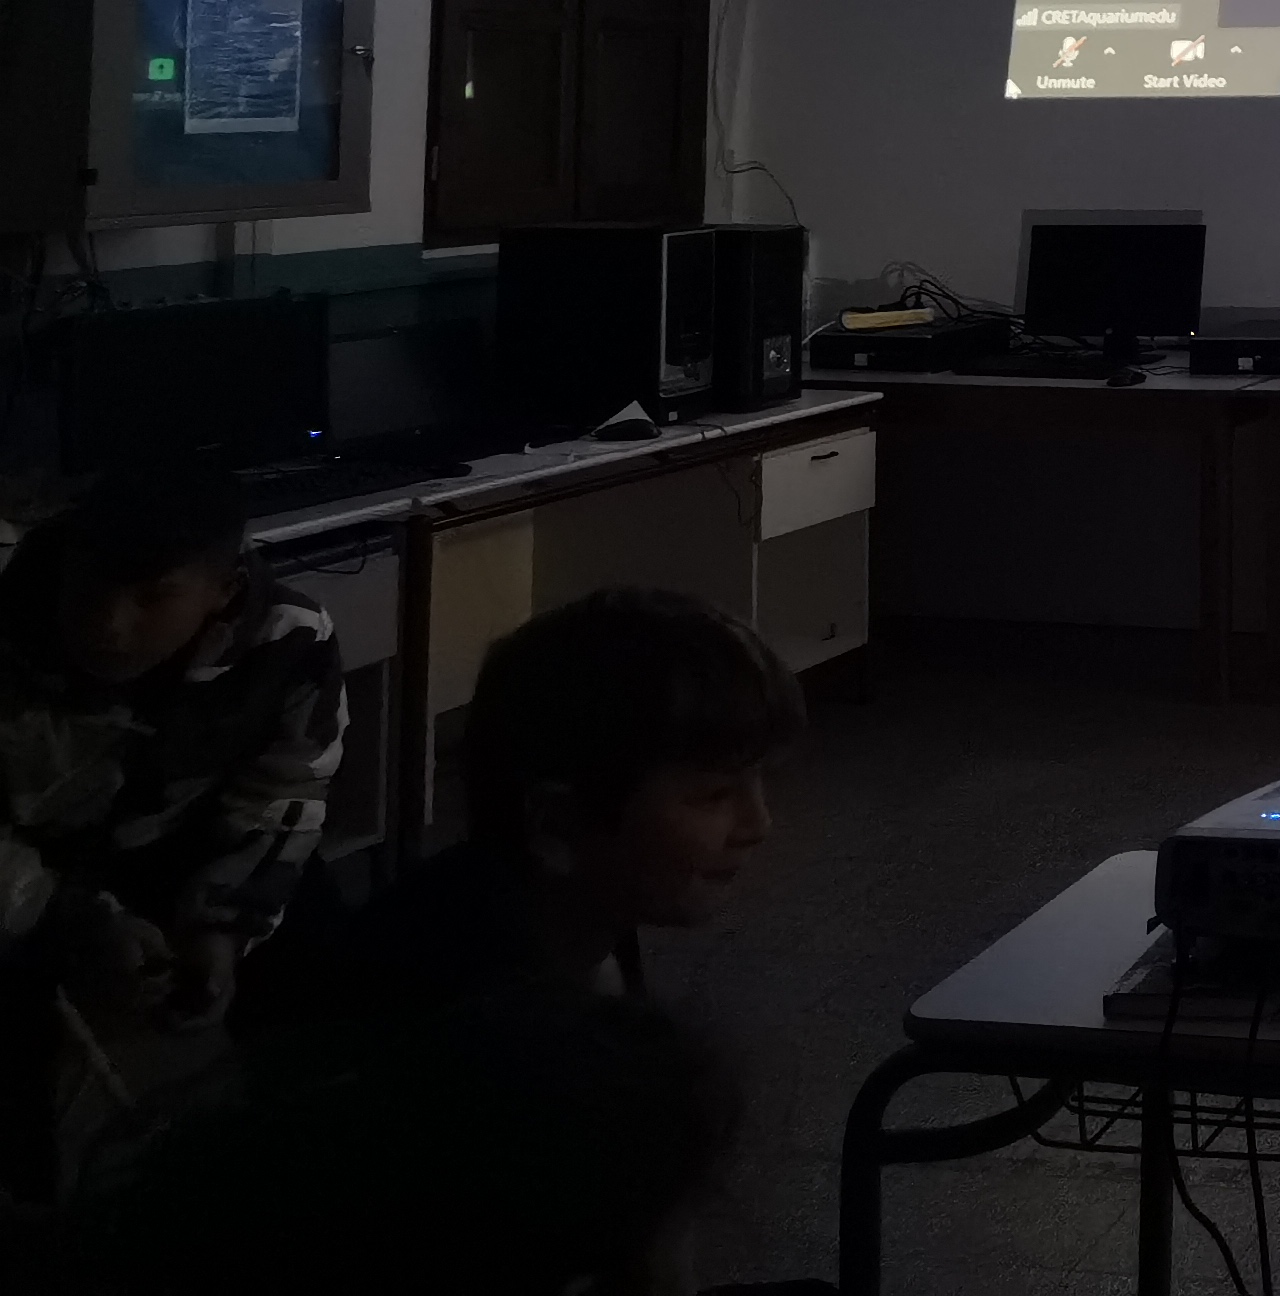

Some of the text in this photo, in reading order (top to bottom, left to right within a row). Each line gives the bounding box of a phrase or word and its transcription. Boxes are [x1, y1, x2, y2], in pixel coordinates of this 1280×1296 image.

[1041, 8, 1177, 27] CRETAquariumedu
[1036, 75, 1096, 89] Unmute
[1143, 73, 1227, 89] Start Video
